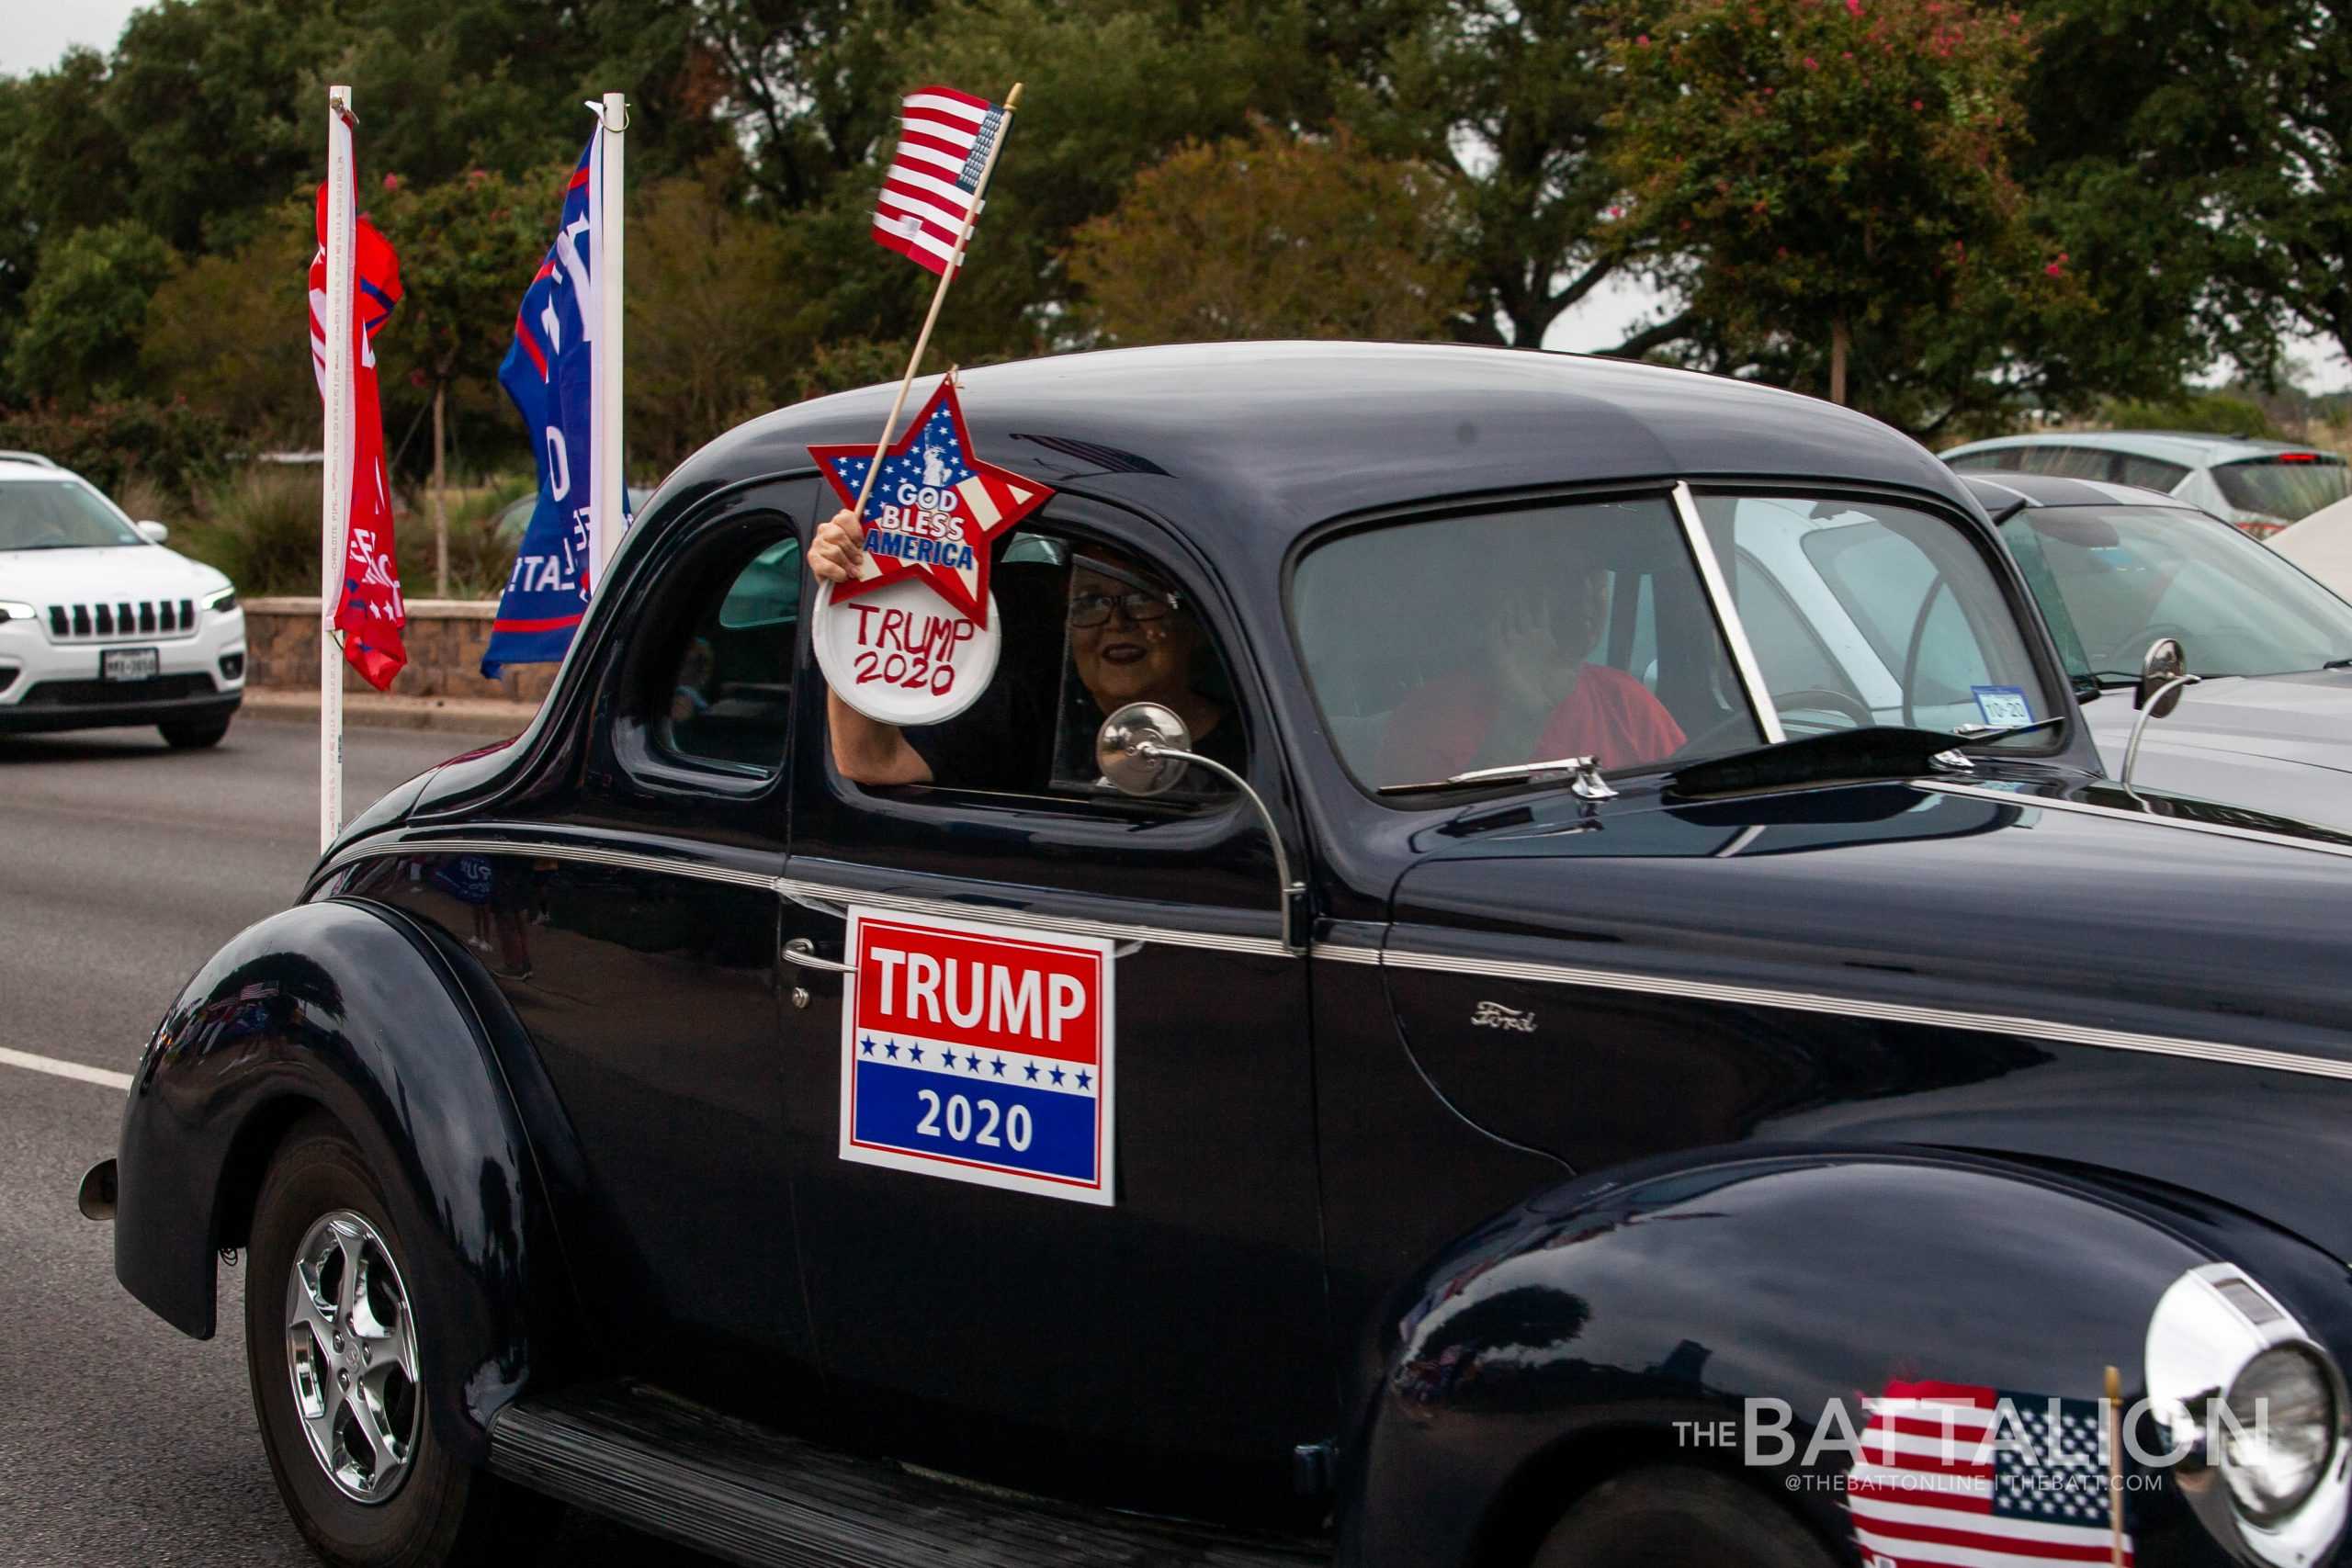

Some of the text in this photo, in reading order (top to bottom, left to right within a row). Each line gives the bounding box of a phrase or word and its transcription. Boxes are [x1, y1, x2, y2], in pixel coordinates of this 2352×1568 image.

[897, 482, 958, 513] GOD
[881, 504, 965, 541] BLESS
[863, 528, 974, 570] AMERICA
[848, 603, 975, 662] TRUMP
[854, 650, 956, 696] 2020
[870, 946, 1087, 1043] TRUMP
[916, 1089, 1034, 1153] 2020
